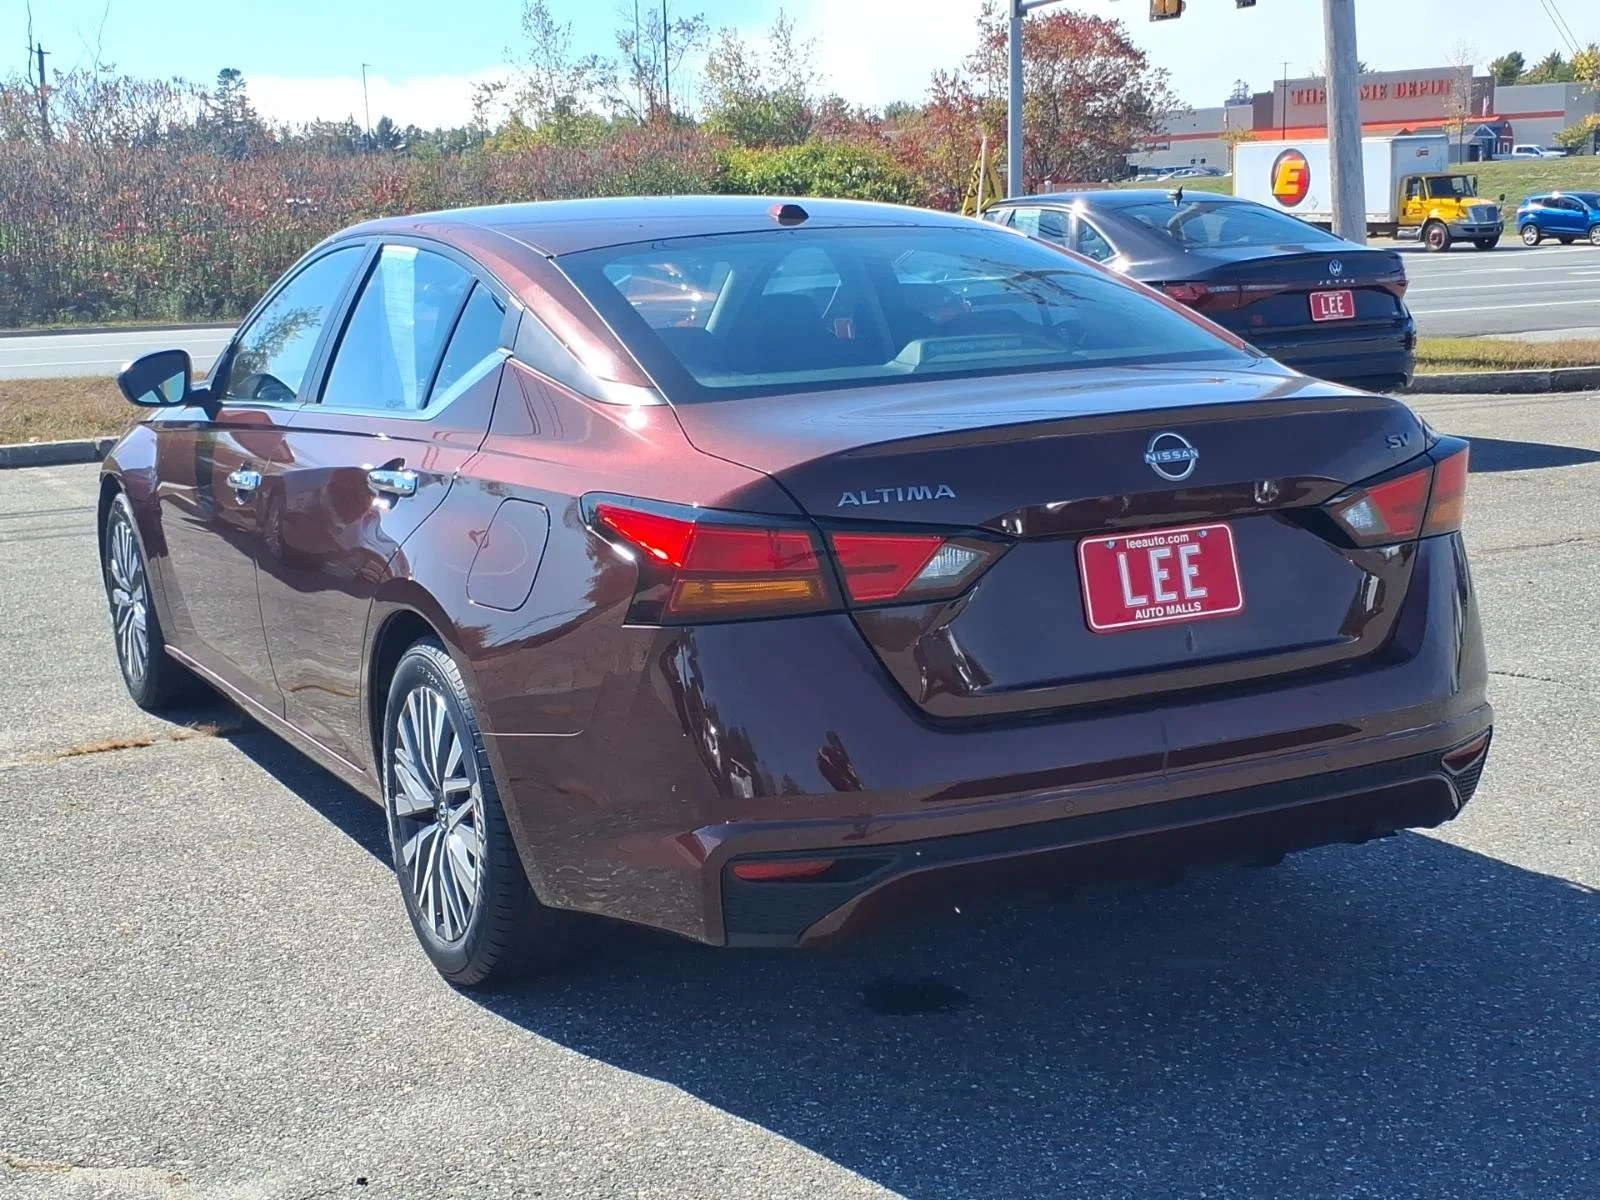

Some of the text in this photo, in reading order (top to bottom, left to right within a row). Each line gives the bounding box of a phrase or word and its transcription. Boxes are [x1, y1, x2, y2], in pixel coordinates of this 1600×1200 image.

[1291, 79, 1452, 105] THE ME DEPOT
[1273, 160, 1305, 195] E
[1320, 296, 1345, 315] LEE
[1386, 432, 1410, 449] SV
[1145, 449, 1199, 464] NISSAN
[837, 484, 957, 507] ALTIMA
[1126, 533, 1190, 549] leeauto.com
[1117, 543, 1208, 608] LEE
[1135, 601, 1202, 620] AUTO MALLS
